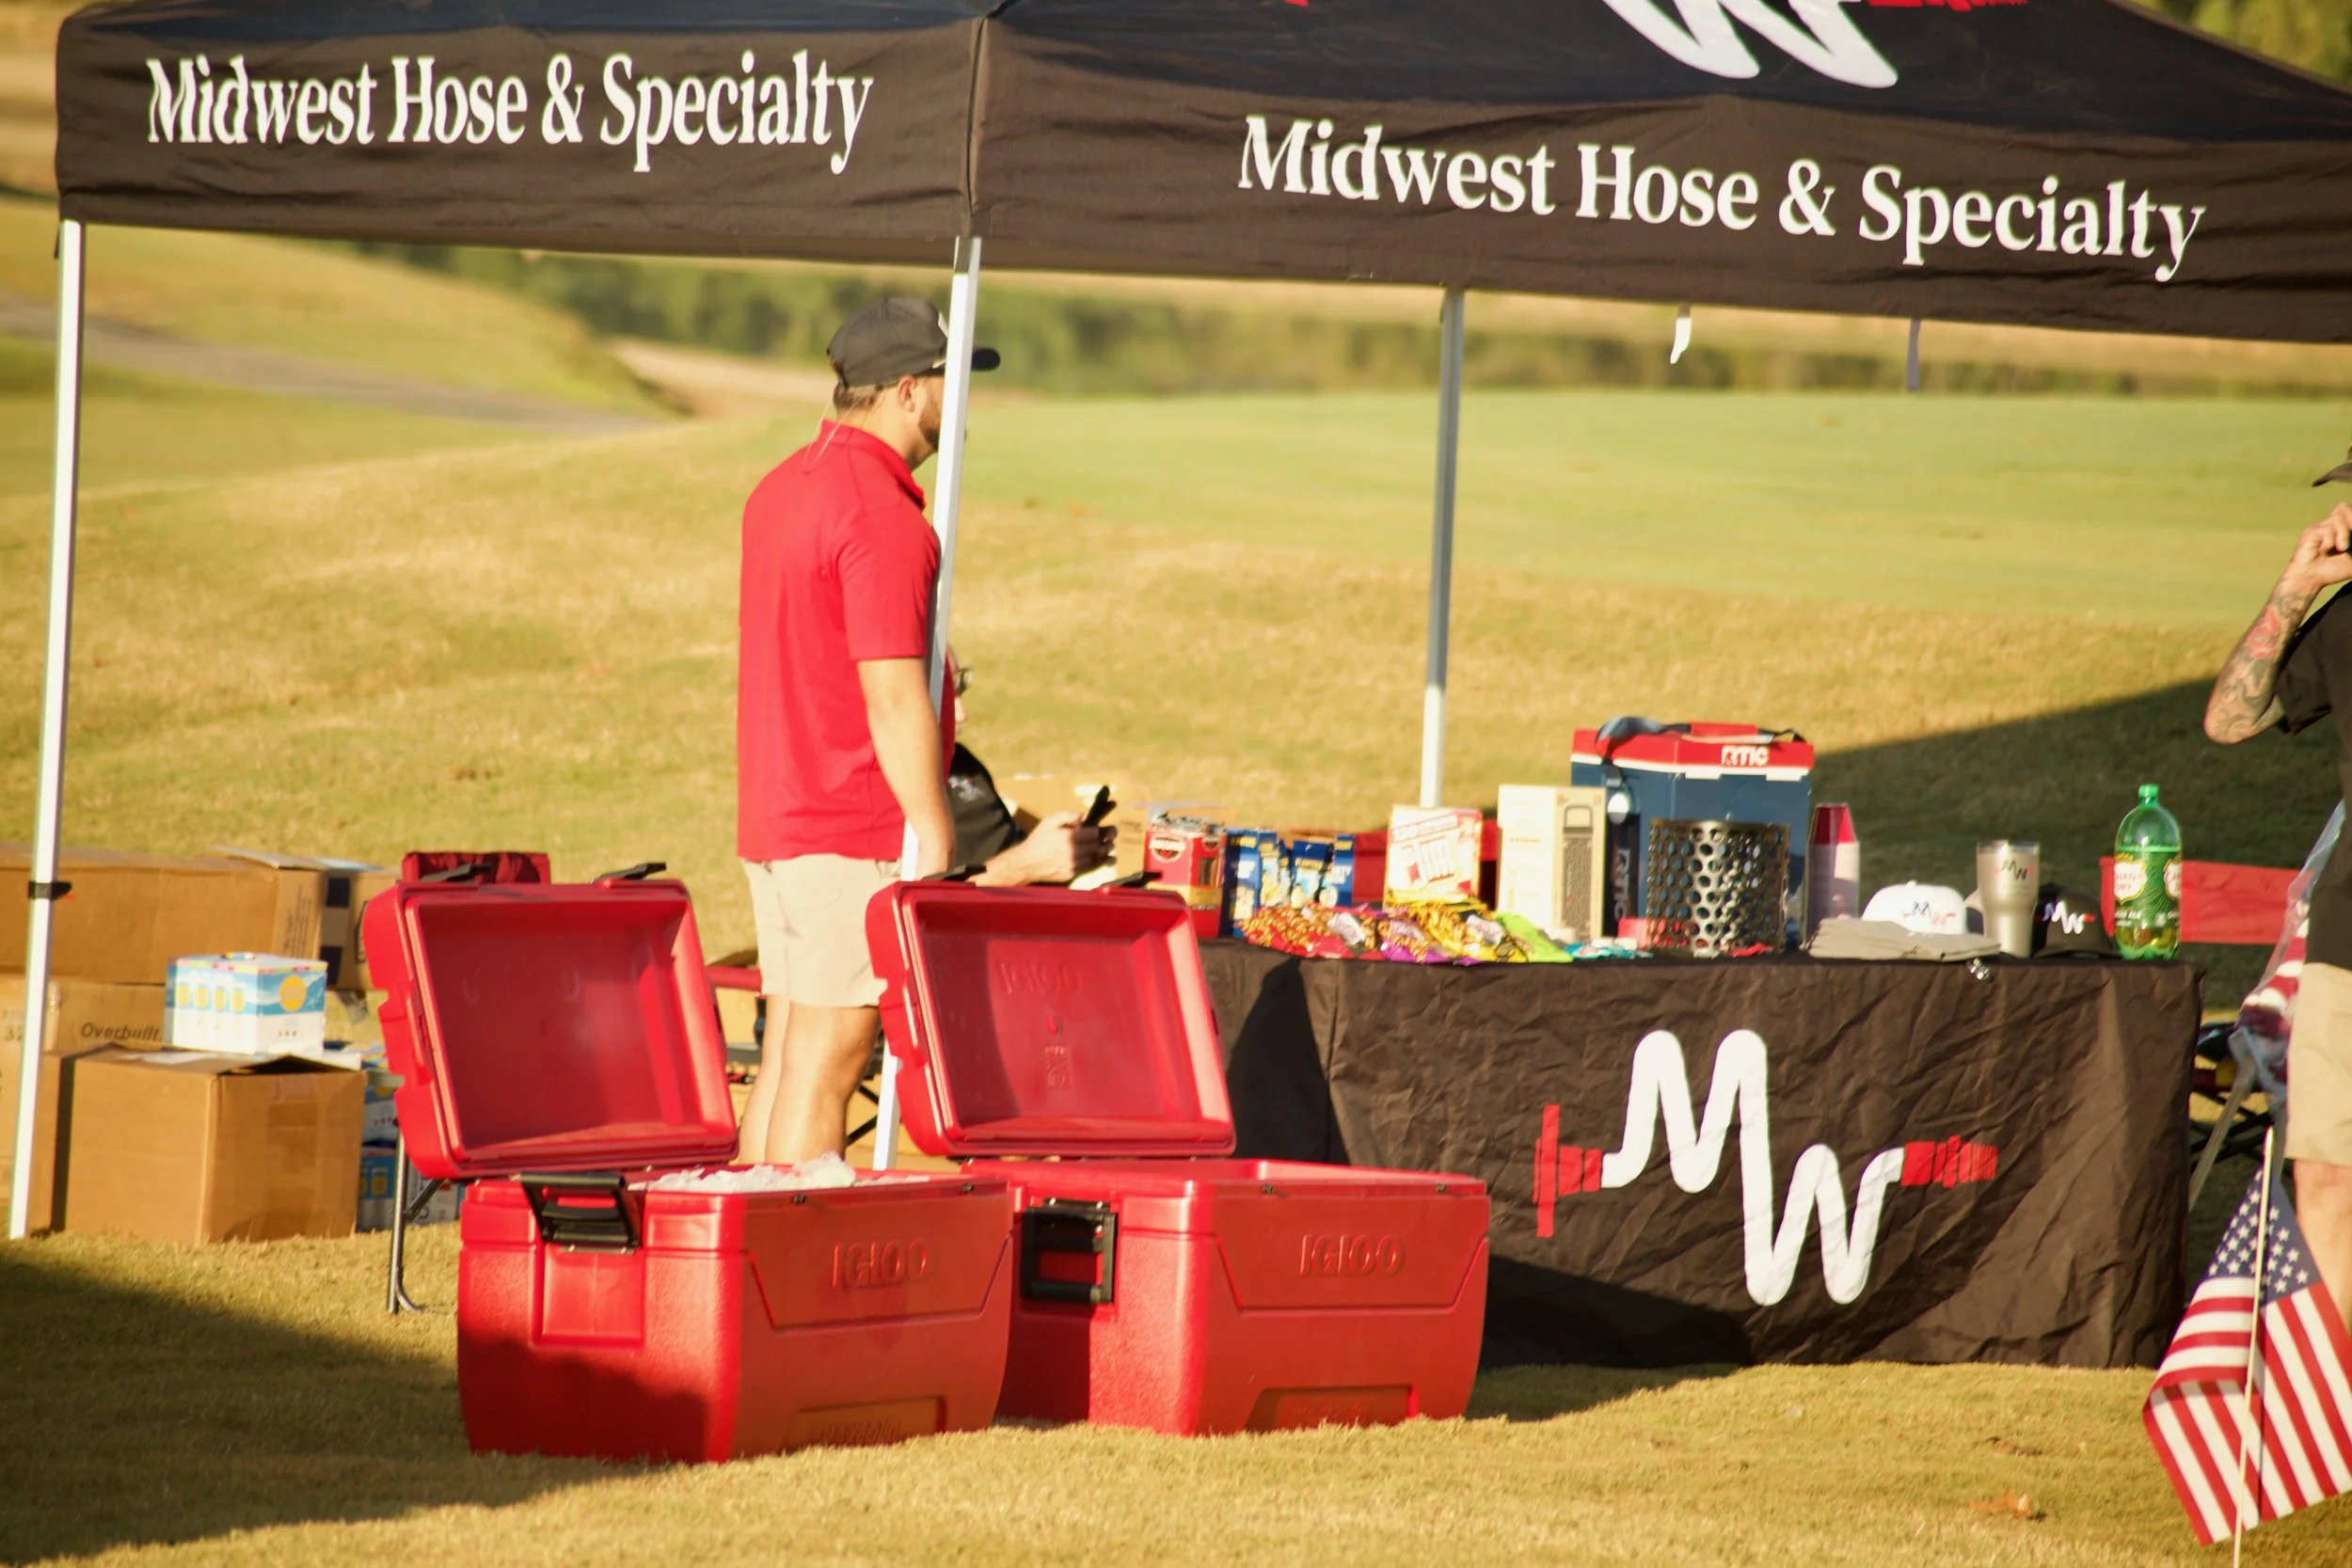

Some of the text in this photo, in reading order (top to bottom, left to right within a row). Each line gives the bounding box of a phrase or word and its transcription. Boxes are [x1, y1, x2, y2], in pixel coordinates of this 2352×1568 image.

[147, 49, 875, 175] Midwest Hose & Specialty
[1237, 116, 2206, 282] Midwest Hose & Specialty
[1721, 744, 1770, 768] RTIC
[1612, 848, 1631, 920] RTIC
[1299, 1232, 1406, 1277] IGLOO
